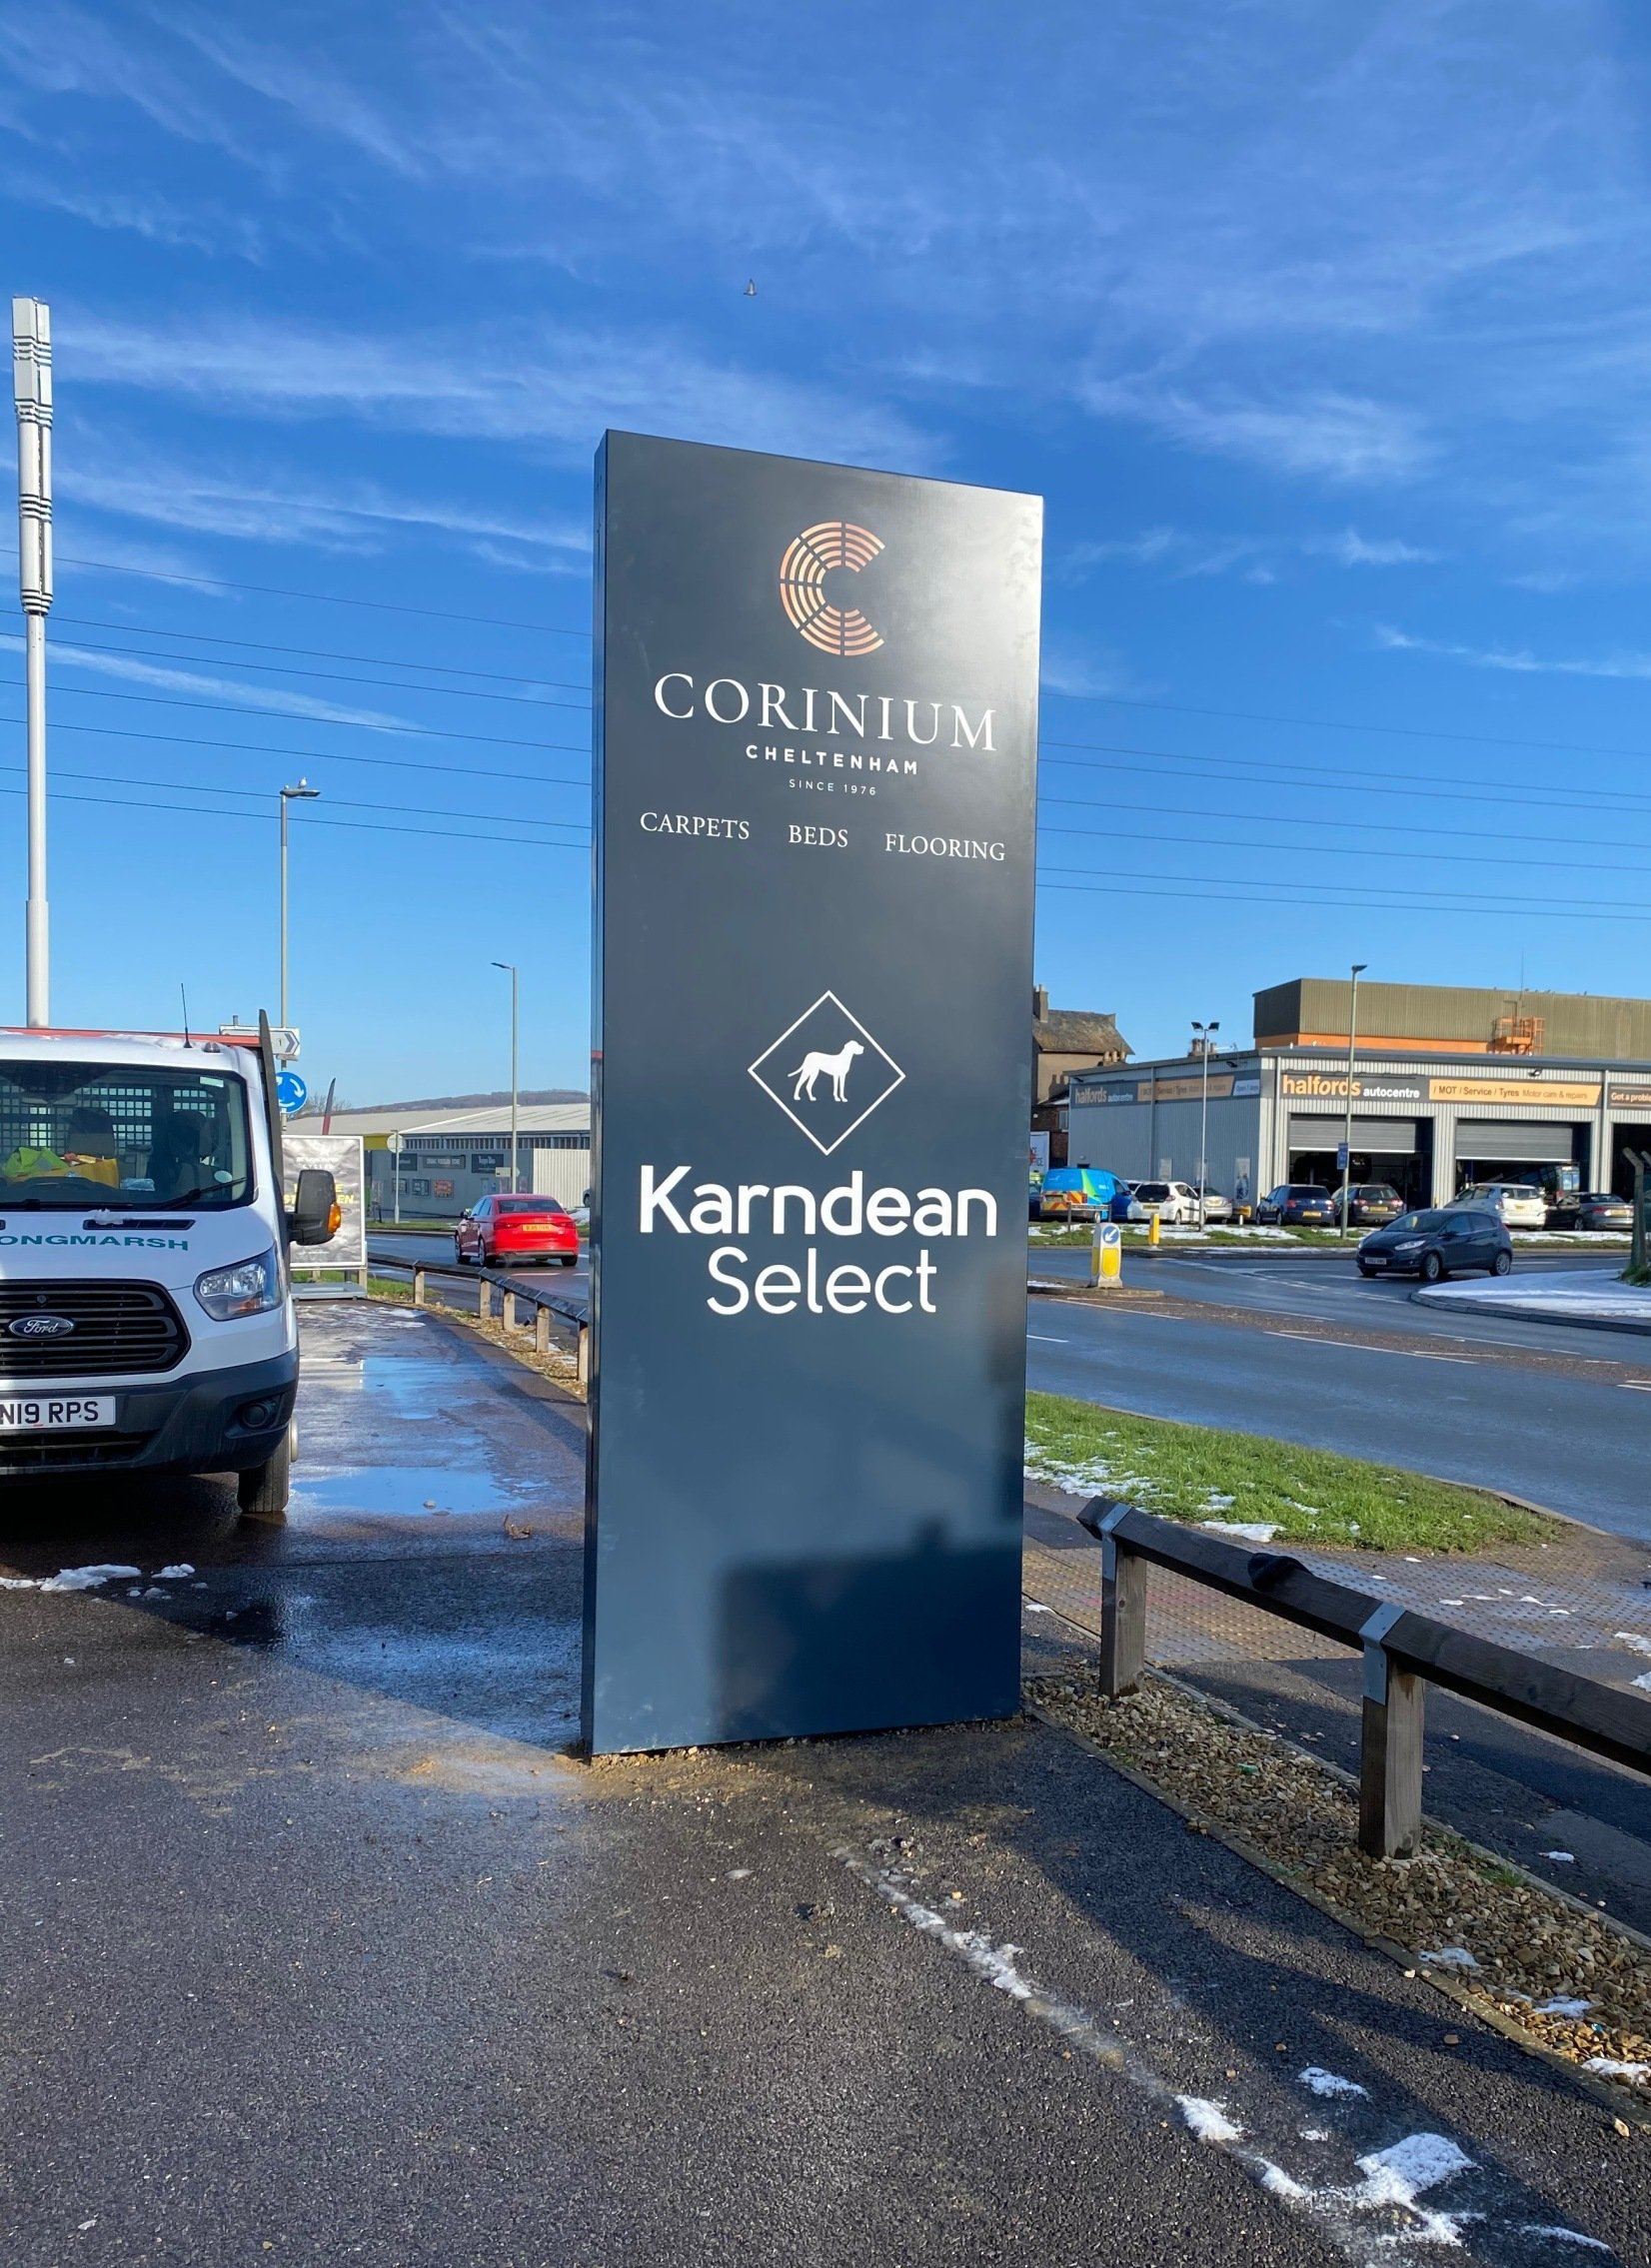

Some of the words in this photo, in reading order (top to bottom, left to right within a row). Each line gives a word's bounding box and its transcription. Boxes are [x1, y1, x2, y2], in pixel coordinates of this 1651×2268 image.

[654, 671, 997, 752] CORINIUM
[745, 743, 919, 775] CHELTENHAM
[789, 778, 835, 792] SINCE
[843, 783, 877, 796] 1976
[640, 811, 751, 841] CARPETS
[788, 824, 849, 848] BEDS
[884, 833, 1006, 862] FLOORING
[1075, 1086, 1107, 1104] halfords
[1282, 1074, 1361, 1096] halfords
[1362, 1086, 1420, 1098] autocentre
[1438, 1085, 1457, 1095] MOT
[1463, 1086, 1492, 1096] Service
[1499, 1087, 1519, 1098] Tyres
[1522, 1088, 1542, 1097] Motor
[1611, 1092, 1625, 1101] Got
[640, 1164, 997, 1237] Karndean
[707, 1247, 937, 1316] Select
[23, 1319, 58, 1334] Ford
[48, 1401, 99, 1423] RPS
